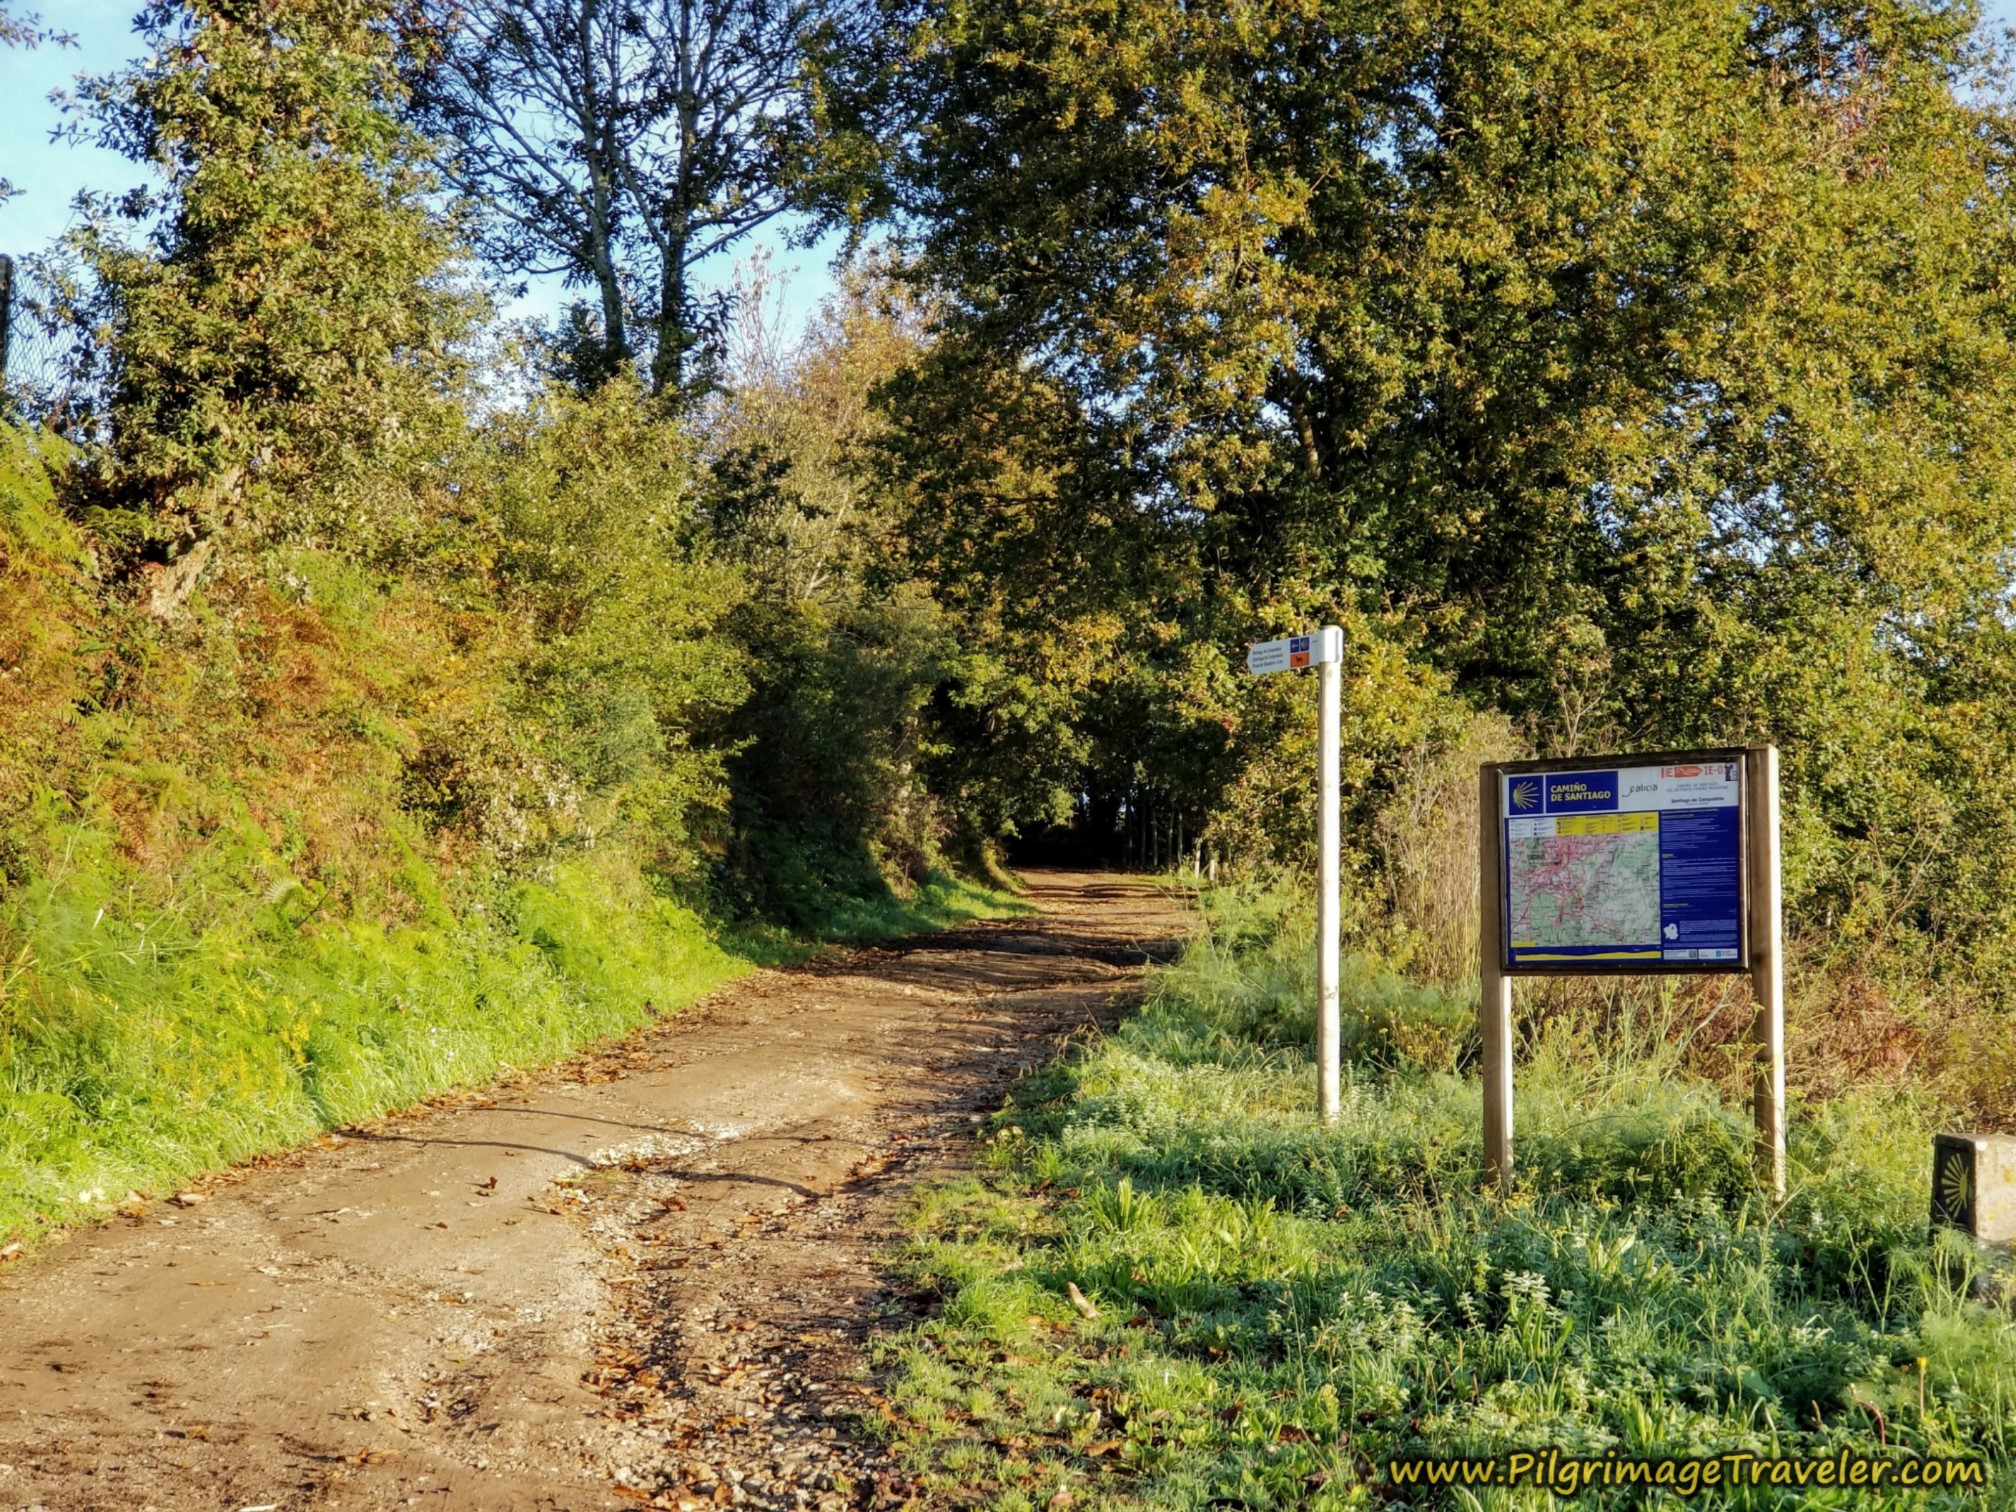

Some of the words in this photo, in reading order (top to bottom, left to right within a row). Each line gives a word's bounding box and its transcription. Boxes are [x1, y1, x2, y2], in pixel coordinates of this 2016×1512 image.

[1551, 782, 1587, 794] CAMIÑO
[1621, 783, 1658, 798] galicia
[1551, 794, 1562, 802] DE
[1565, 791, 1611, 801] SANTIAGO
